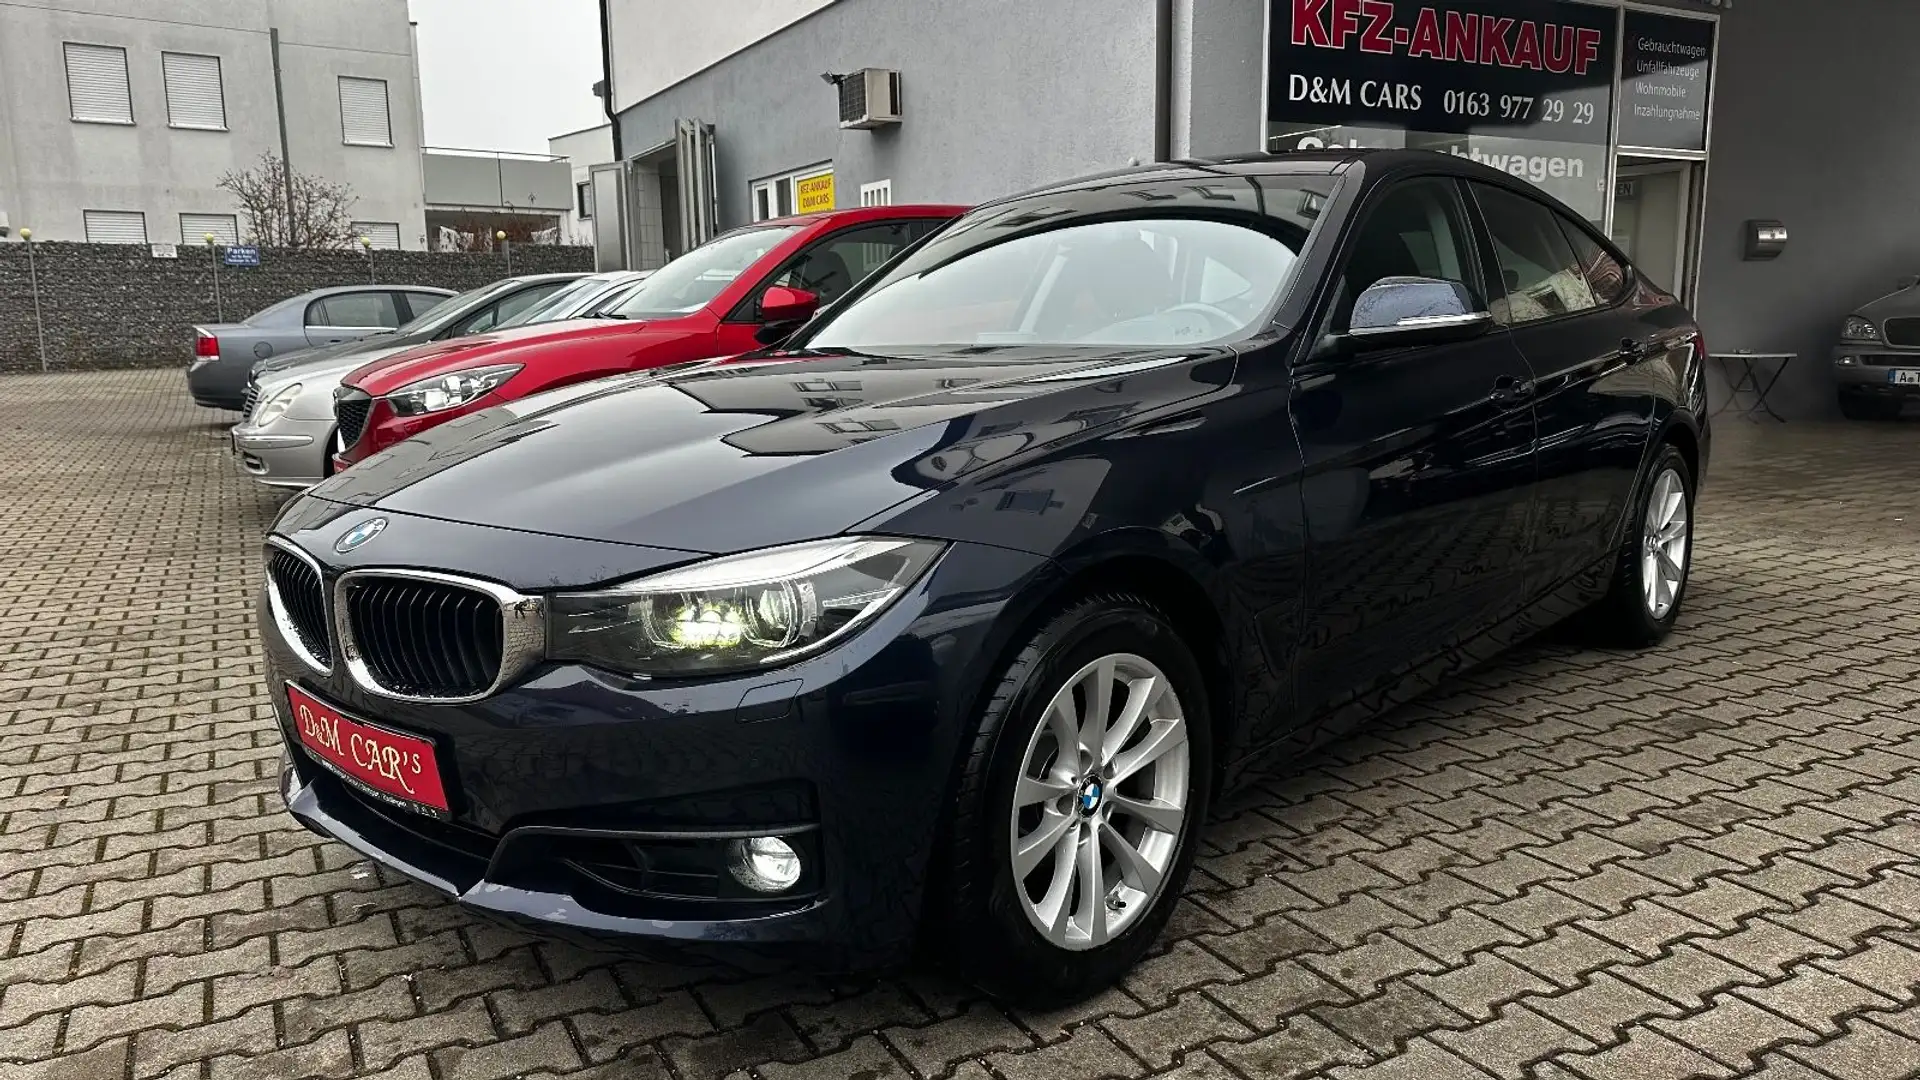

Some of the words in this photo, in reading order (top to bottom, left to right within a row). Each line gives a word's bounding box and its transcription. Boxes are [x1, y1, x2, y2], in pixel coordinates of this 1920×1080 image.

[1291, 0, 1601, 75] KFZ-ANKAUF
[1637, 37, 1707, 59] Gebrauchtwagen
[1636, 60, 1701, 81] Unfallfahrzeuge
[1289, 74, 1351, 105] D&M
[1359, 80, 1422, 111] CARS
[1443, 89, 1490, 117] 0163
[1500, 95, 1534, 120] 977
[1542, 98, 1564, 123] 29
[1572, 102, 1594, 125] 29
[1635, 81, 1687, 98] Wohnmobile
[1634, 103, 1701, 122] Inzahlungnahme
